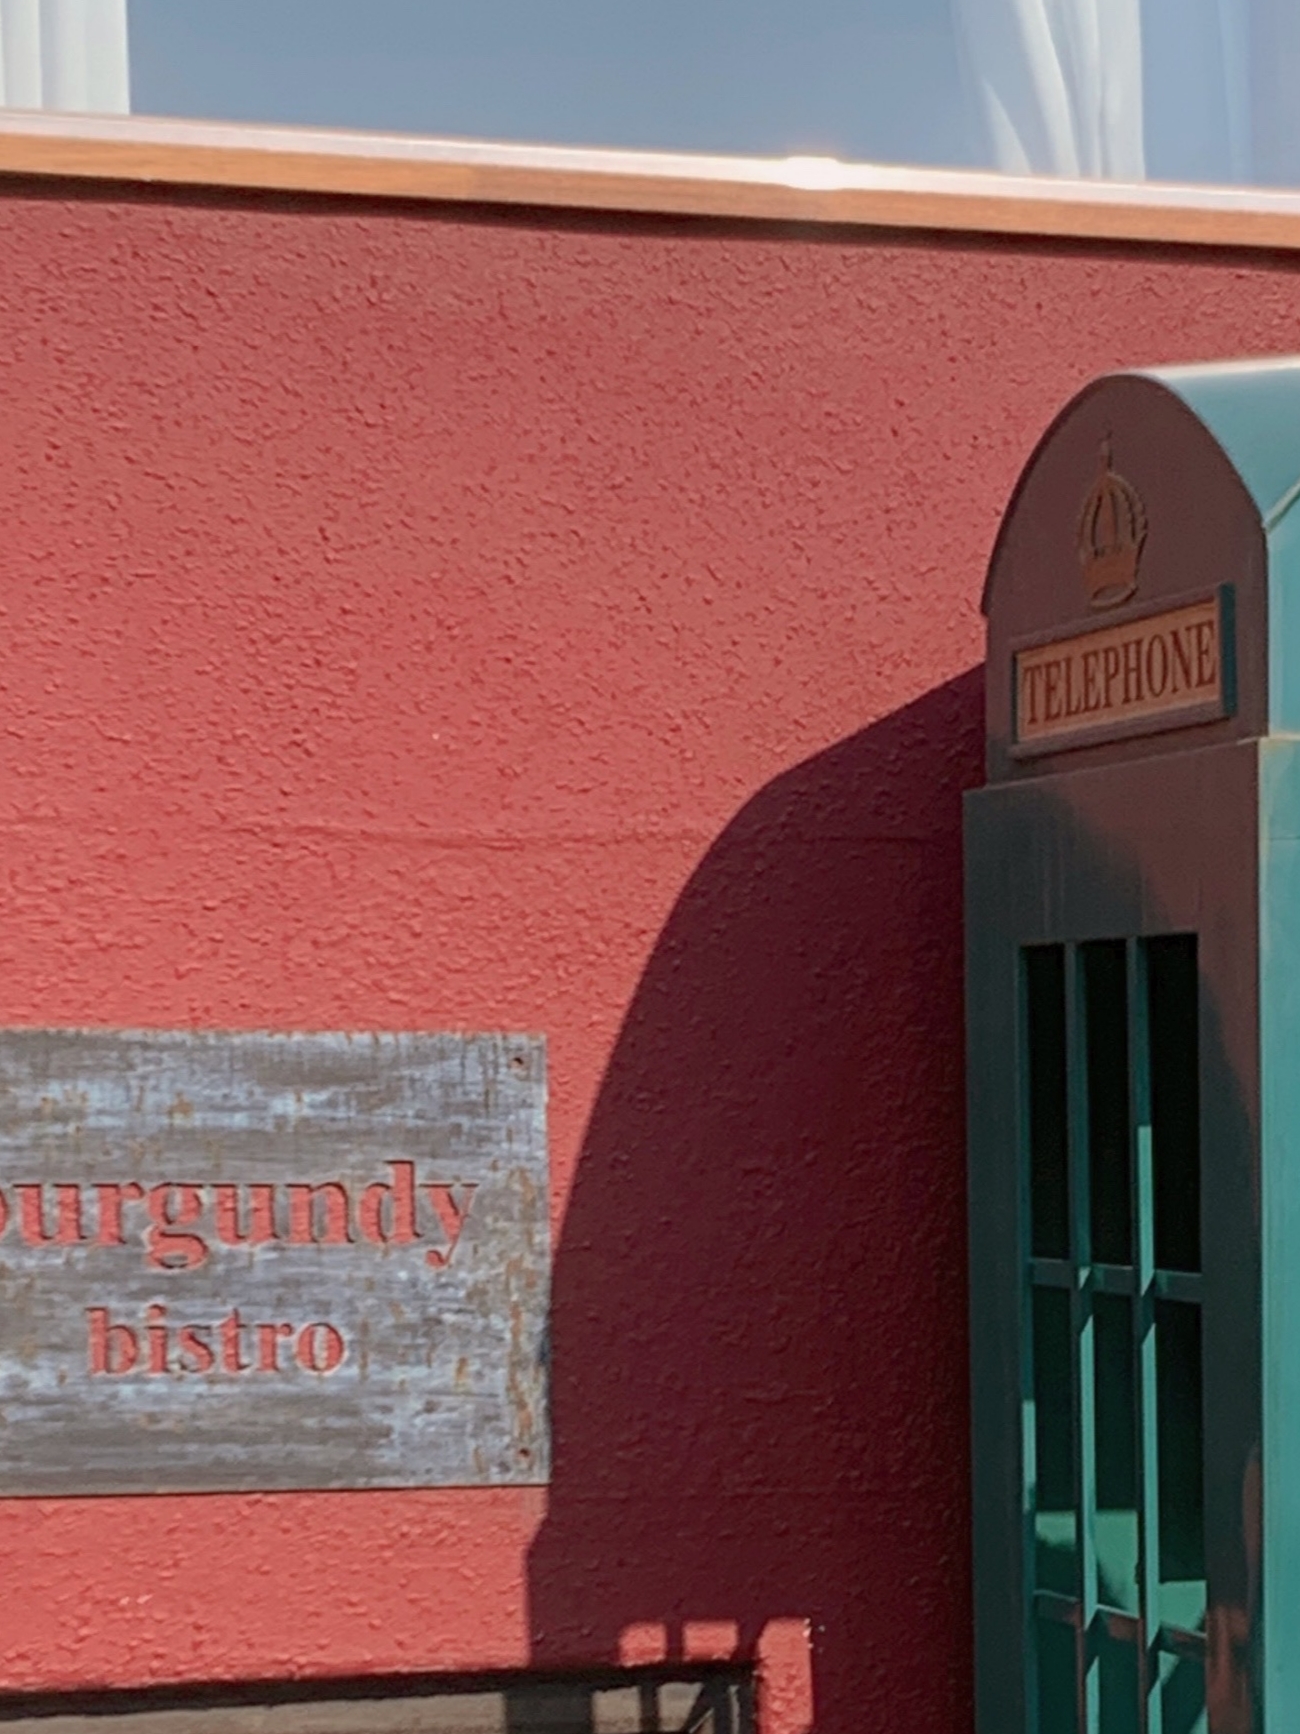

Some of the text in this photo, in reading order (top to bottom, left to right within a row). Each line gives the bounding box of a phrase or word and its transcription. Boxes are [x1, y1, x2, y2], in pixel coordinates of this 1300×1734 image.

[1022, 618, 1216, 725] TELEPHONE
[0, 1160, 478, 1270] urgundy
[86, 1304, 348, 1375] bistro
